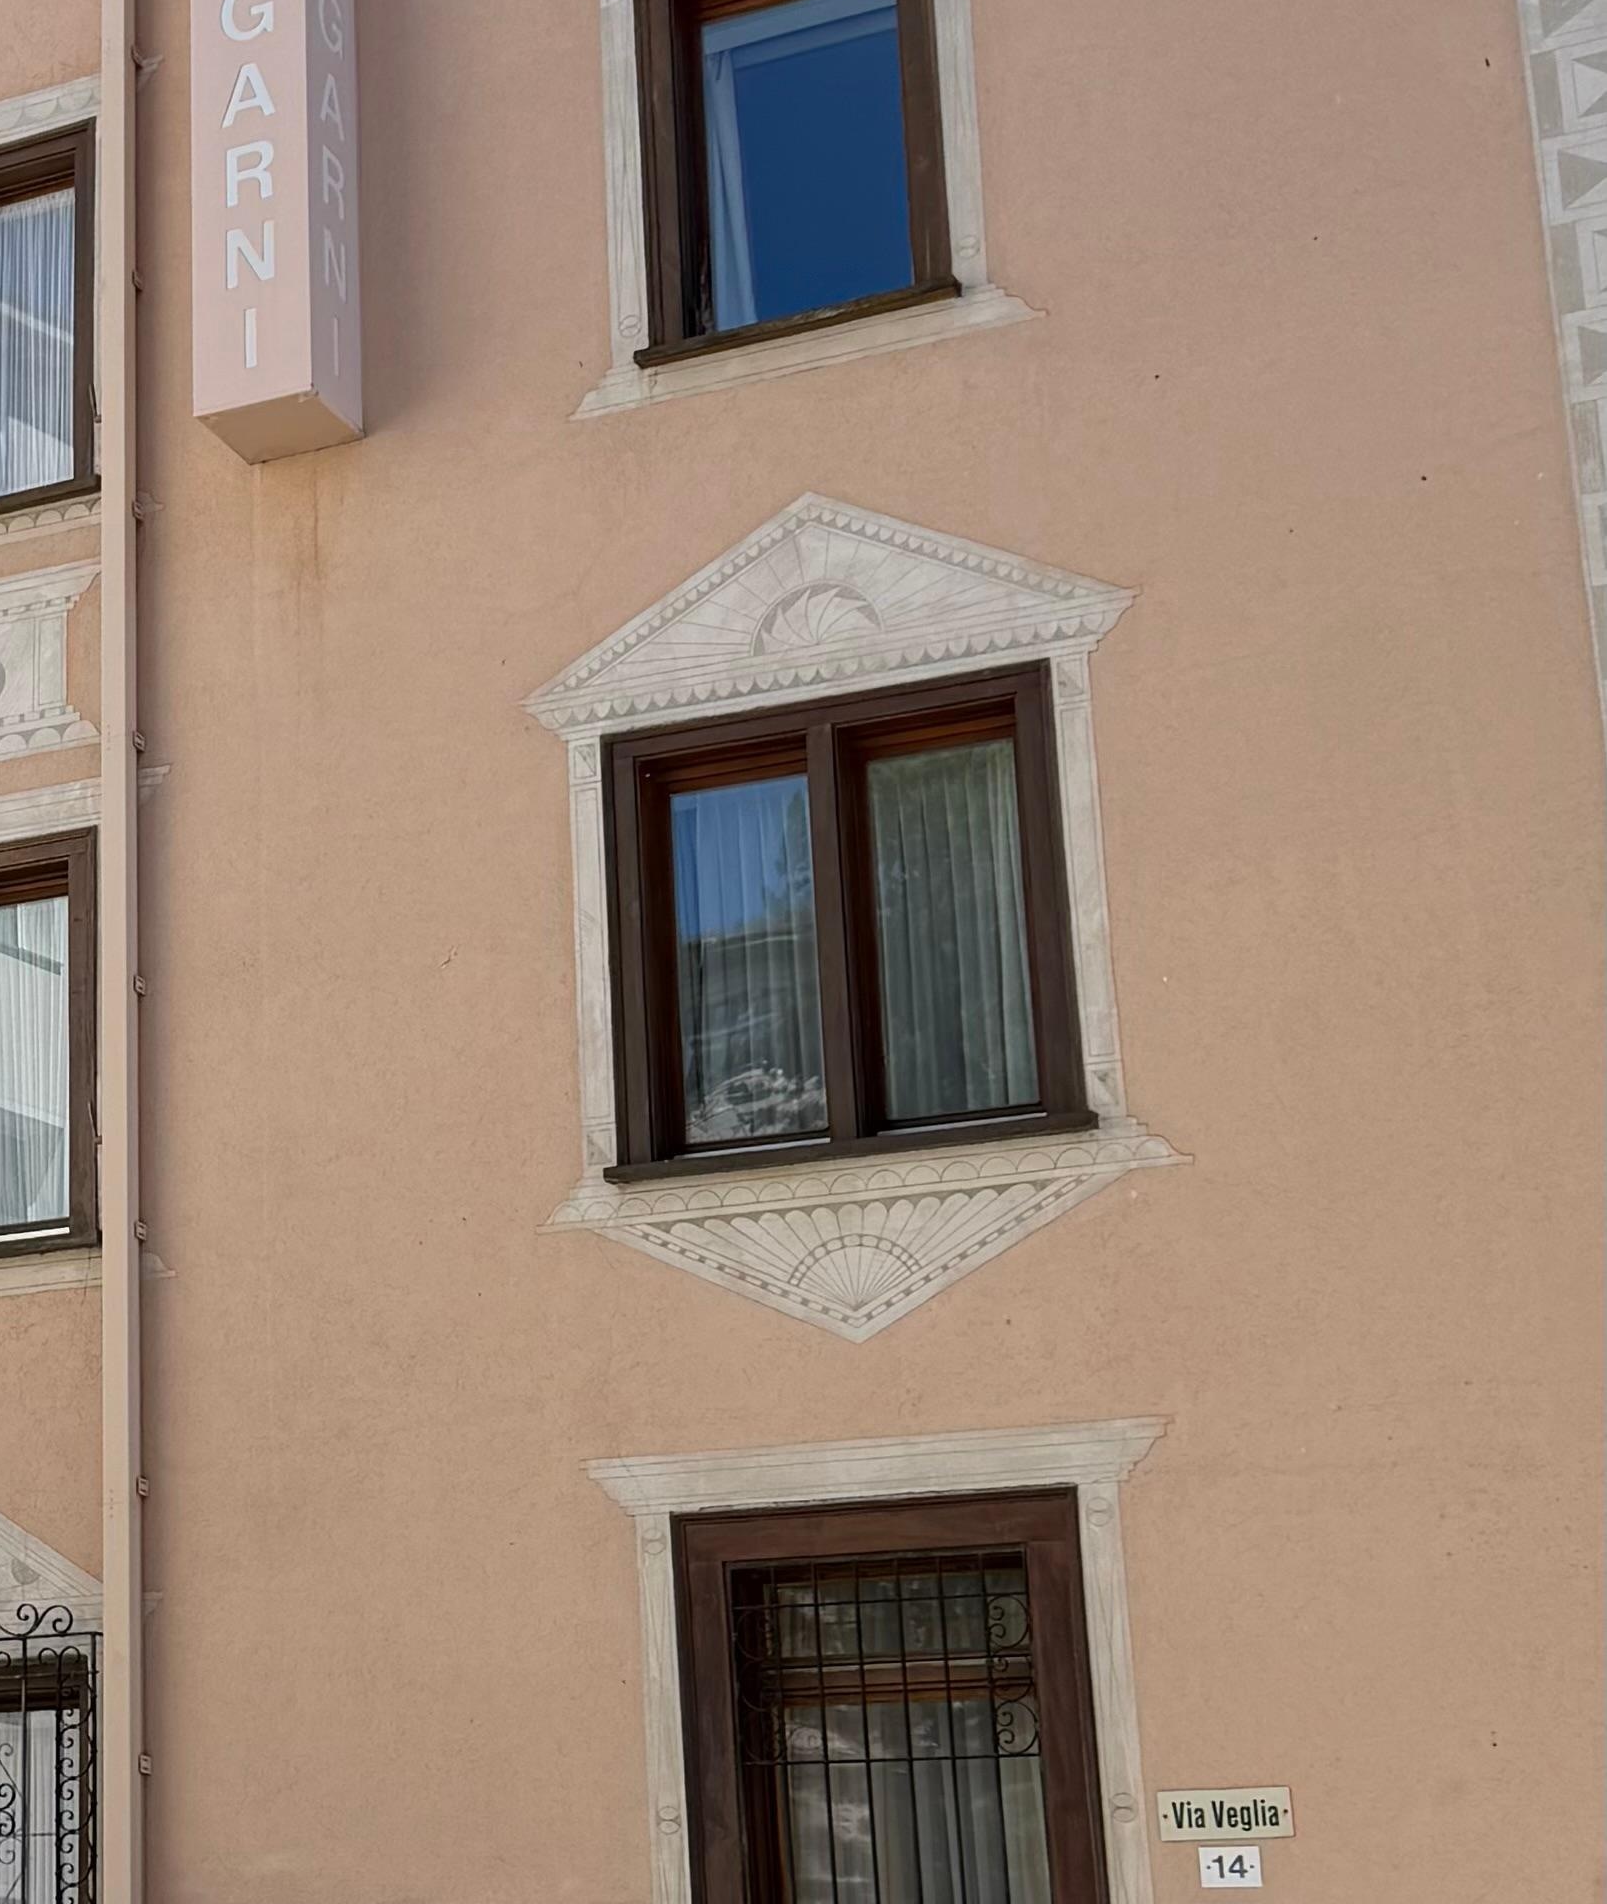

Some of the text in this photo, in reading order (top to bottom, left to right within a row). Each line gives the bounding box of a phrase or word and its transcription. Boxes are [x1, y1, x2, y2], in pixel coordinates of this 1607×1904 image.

[1171, 1798, 1280, 1832] Via Veglia
[1211, 1854, 1249, 1879] 14
